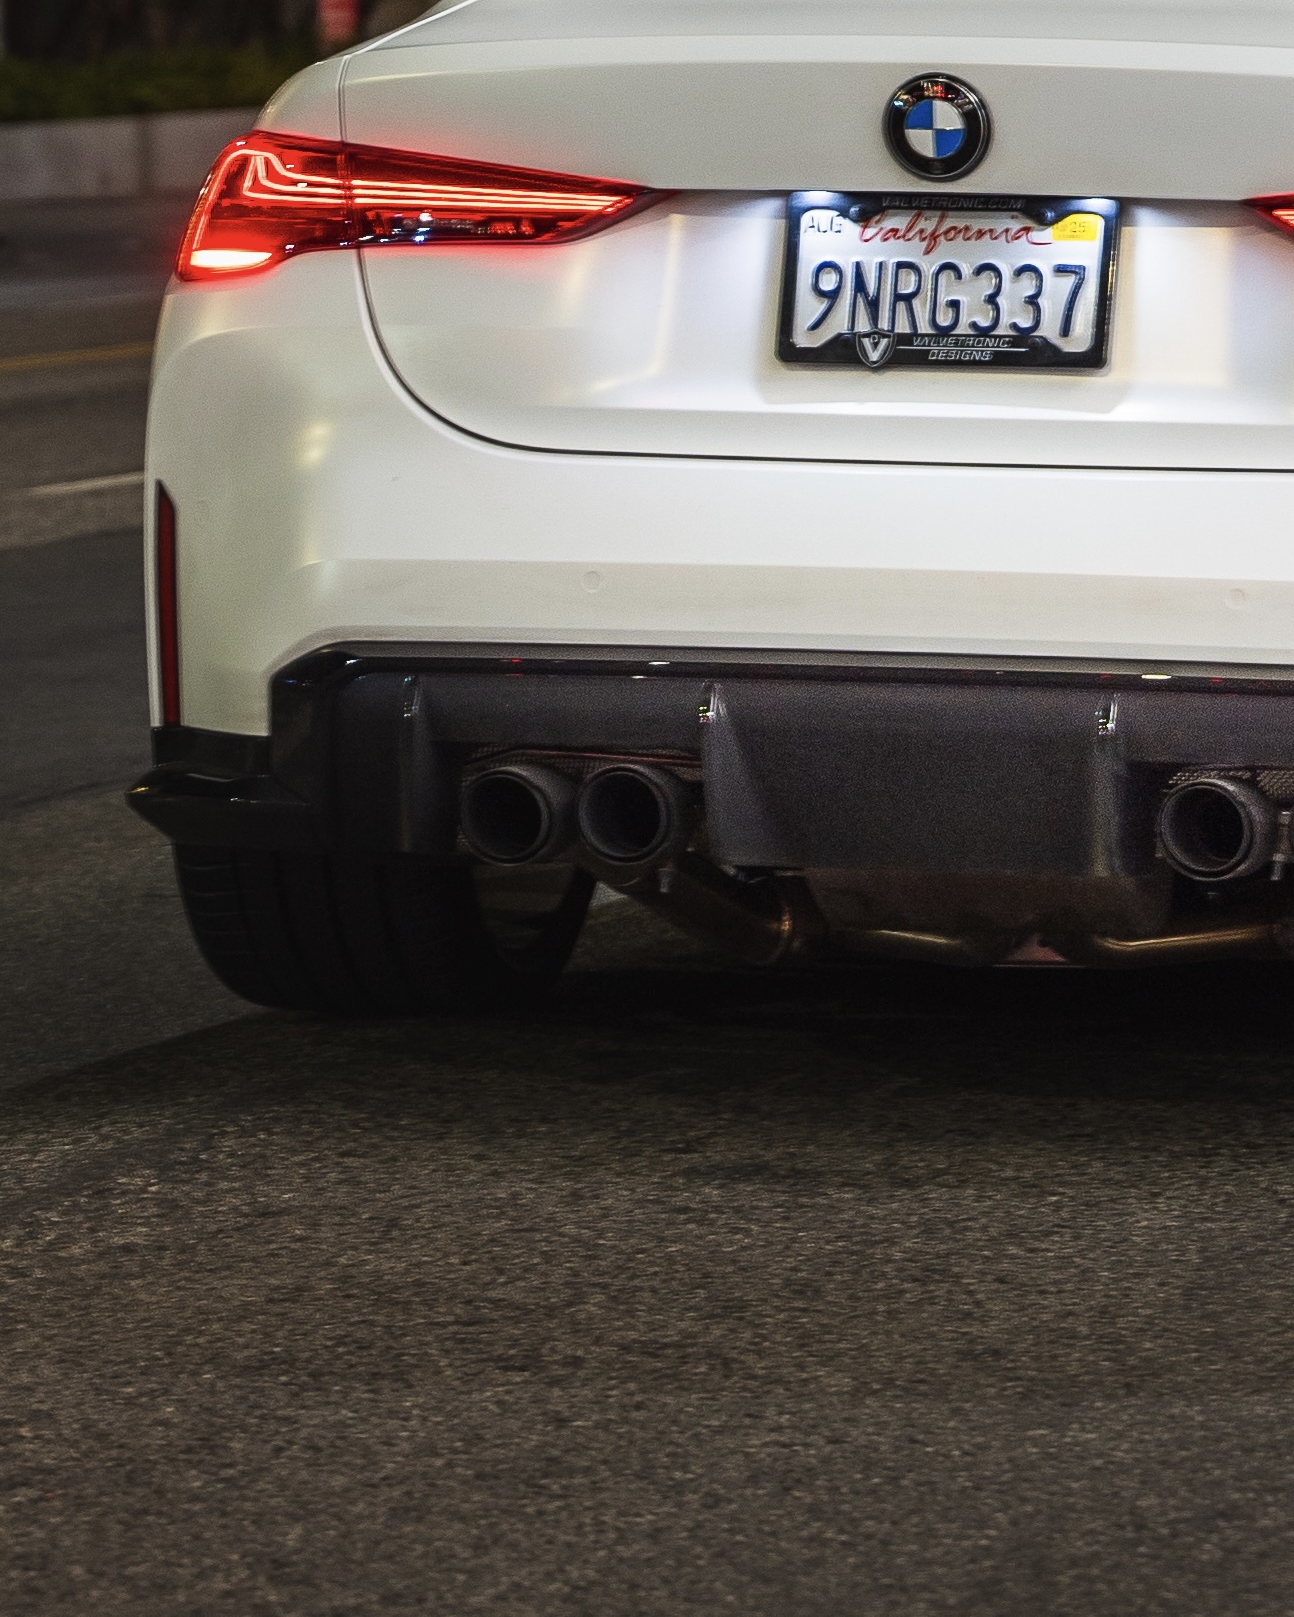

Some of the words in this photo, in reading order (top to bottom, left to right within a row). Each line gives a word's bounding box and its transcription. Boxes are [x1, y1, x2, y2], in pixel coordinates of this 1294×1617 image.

[803, 214, 842, 234] AUG
[858, 209, 1052, 256] California
[806, 260, 1087, 337] 9NRG337
[912, 336, 1013, 348] VALVETRONIC
[927, 350, 994, 361] DESIGNS
